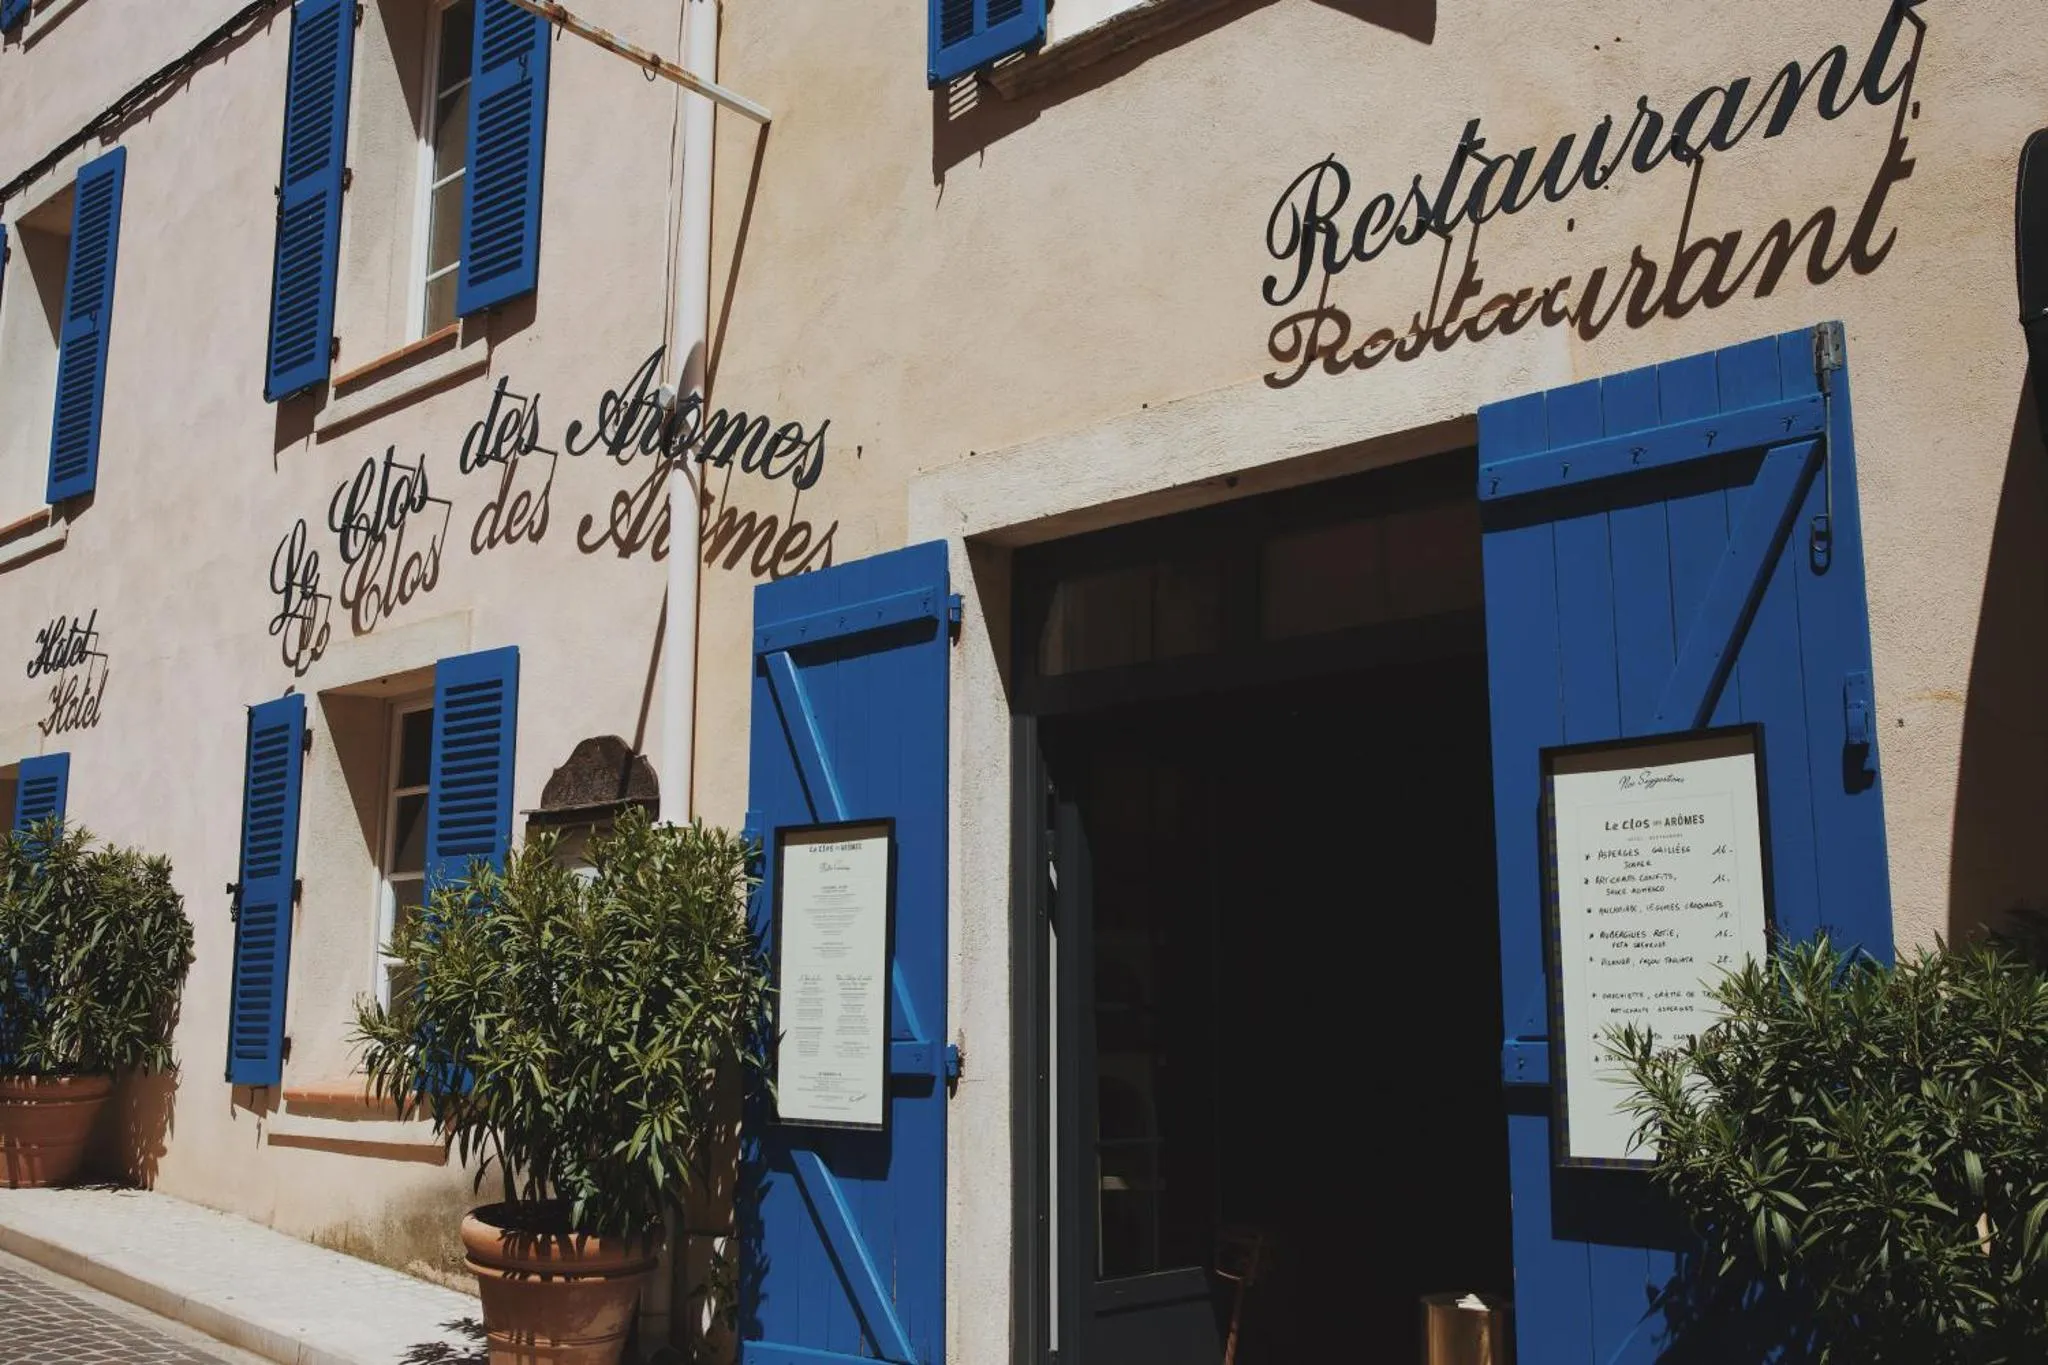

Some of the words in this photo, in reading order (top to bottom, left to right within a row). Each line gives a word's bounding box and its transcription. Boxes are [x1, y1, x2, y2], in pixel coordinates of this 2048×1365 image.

[1263, 0, 1926, 306] Restaurant
[269, 518, 320, 635] Le
[328, 444, 429, 564] Clos
[460, 376, 541, 474] des
[1664, 812, 1705, 827] ARÔMES
